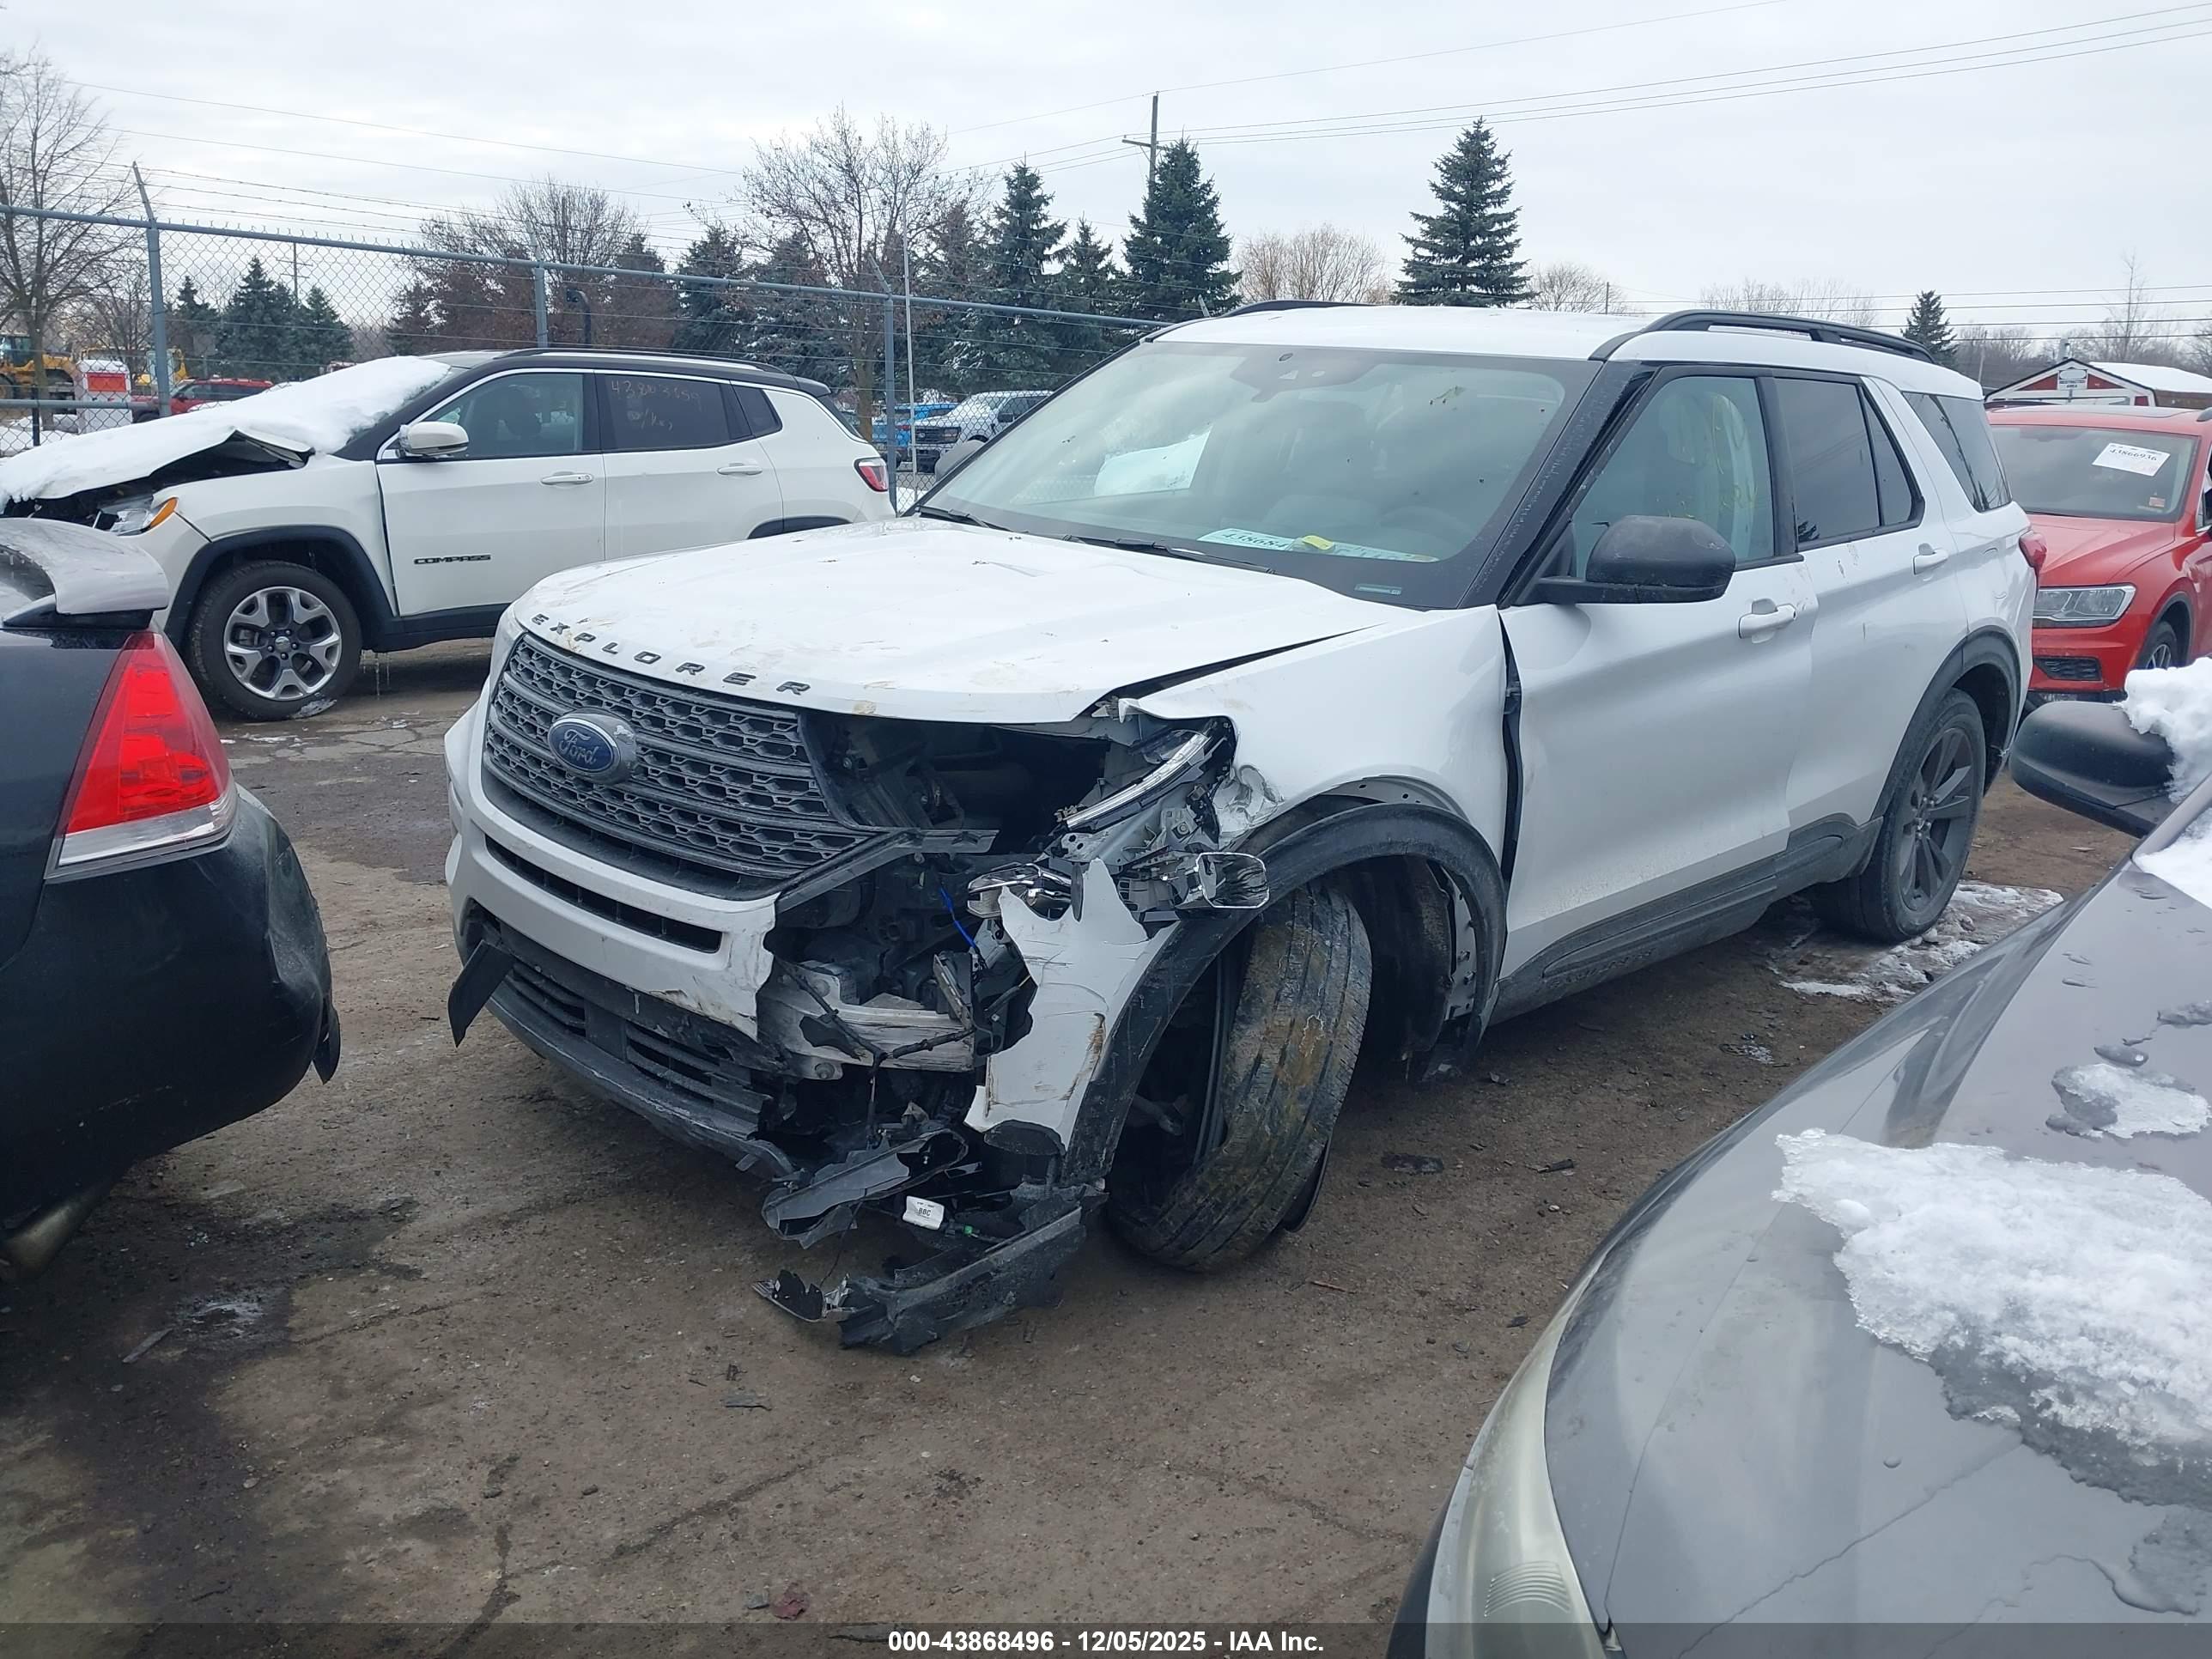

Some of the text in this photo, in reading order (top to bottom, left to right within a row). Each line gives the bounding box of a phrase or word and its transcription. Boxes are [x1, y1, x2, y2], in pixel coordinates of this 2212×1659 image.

[414, 555, 491, 564] COMPASS
[531, 613, 811, 696] EXPLORER
[558, 728, 600, 765] Ford
